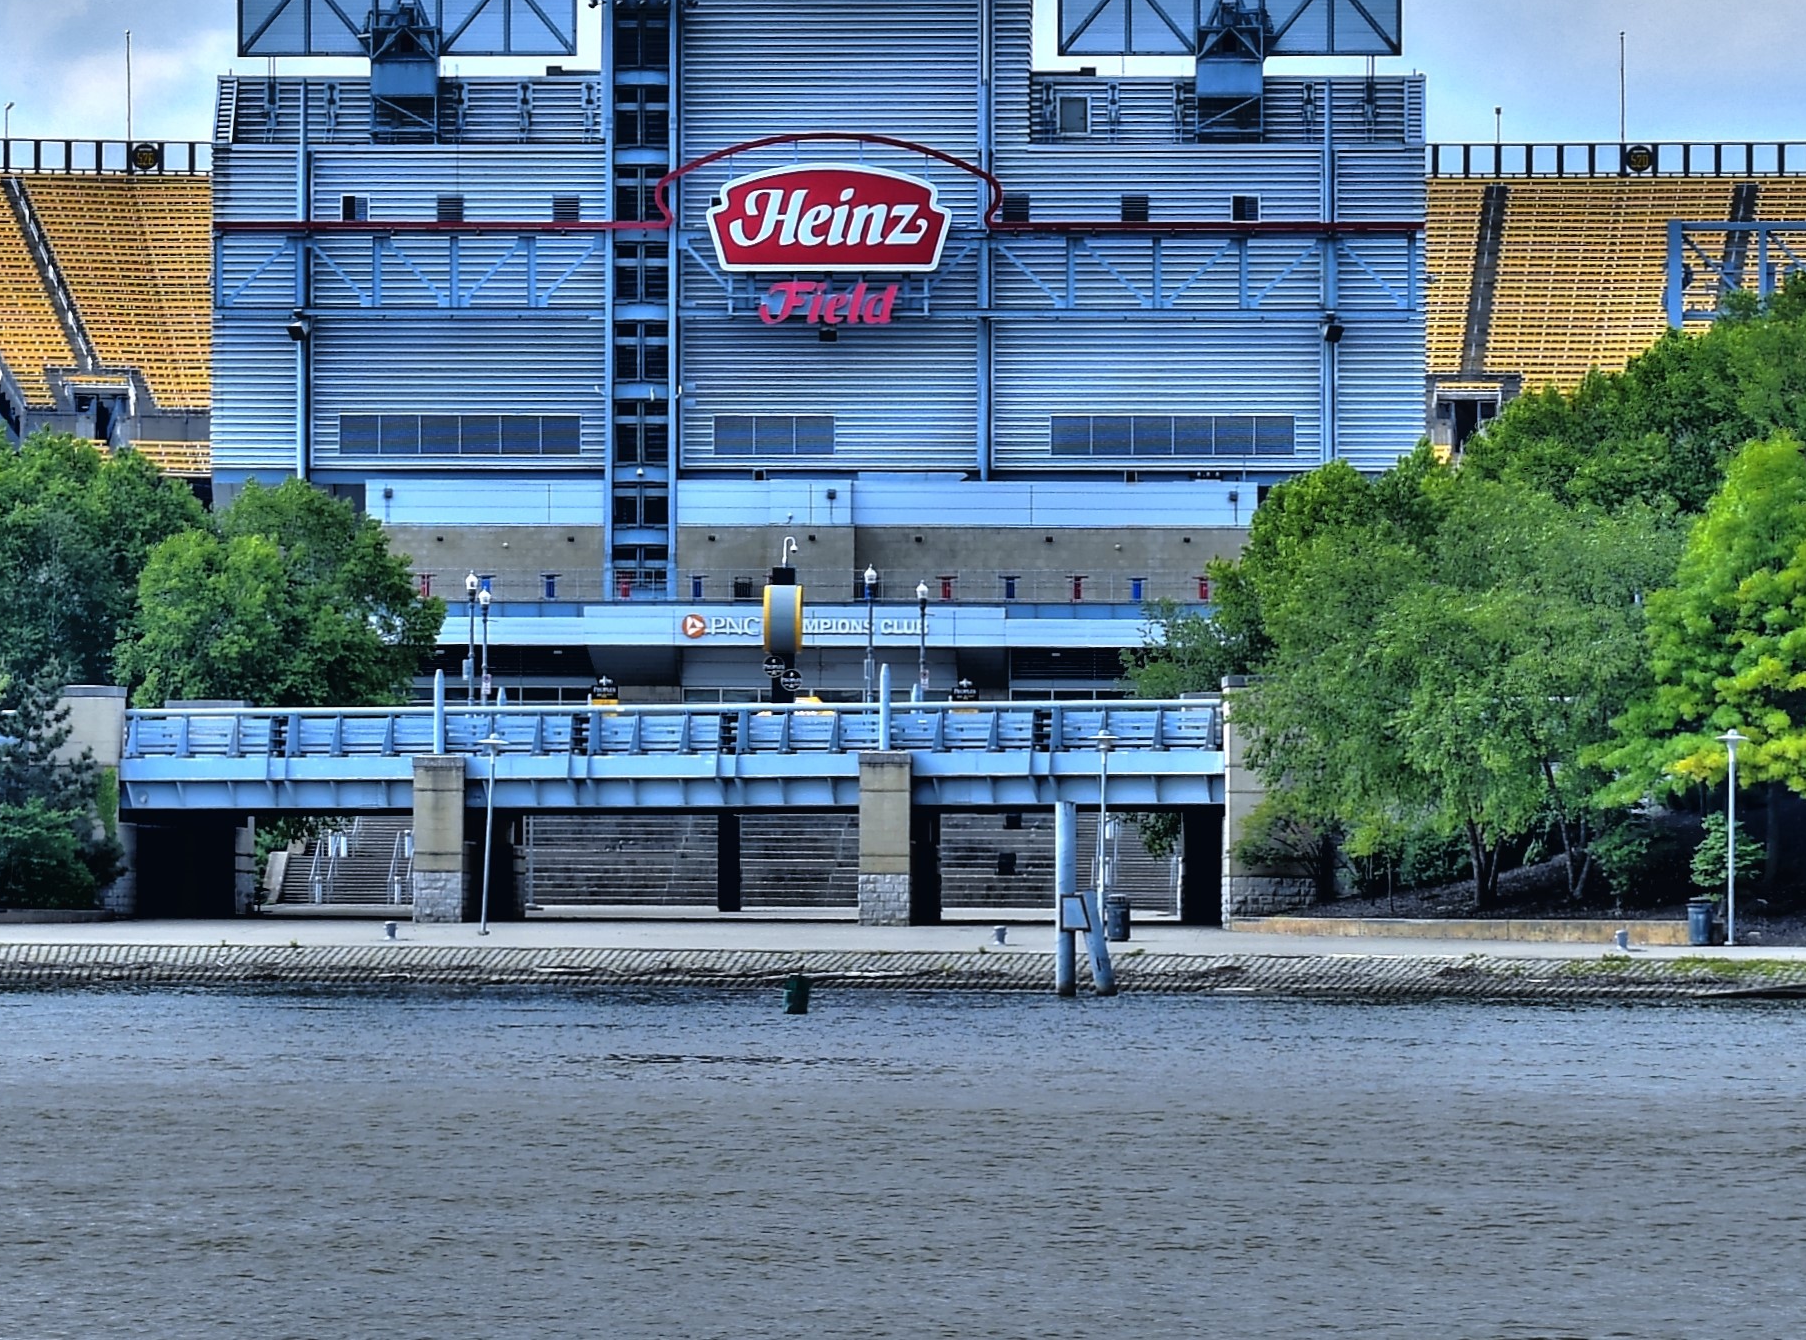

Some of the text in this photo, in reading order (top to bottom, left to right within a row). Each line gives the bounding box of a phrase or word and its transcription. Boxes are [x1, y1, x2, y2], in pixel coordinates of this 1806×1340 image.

[728, 187, 928, 246] Heinz
[758, 281, 899, 325] Field
[710, 617, 930, 636] PNC MPIONS CLUB
